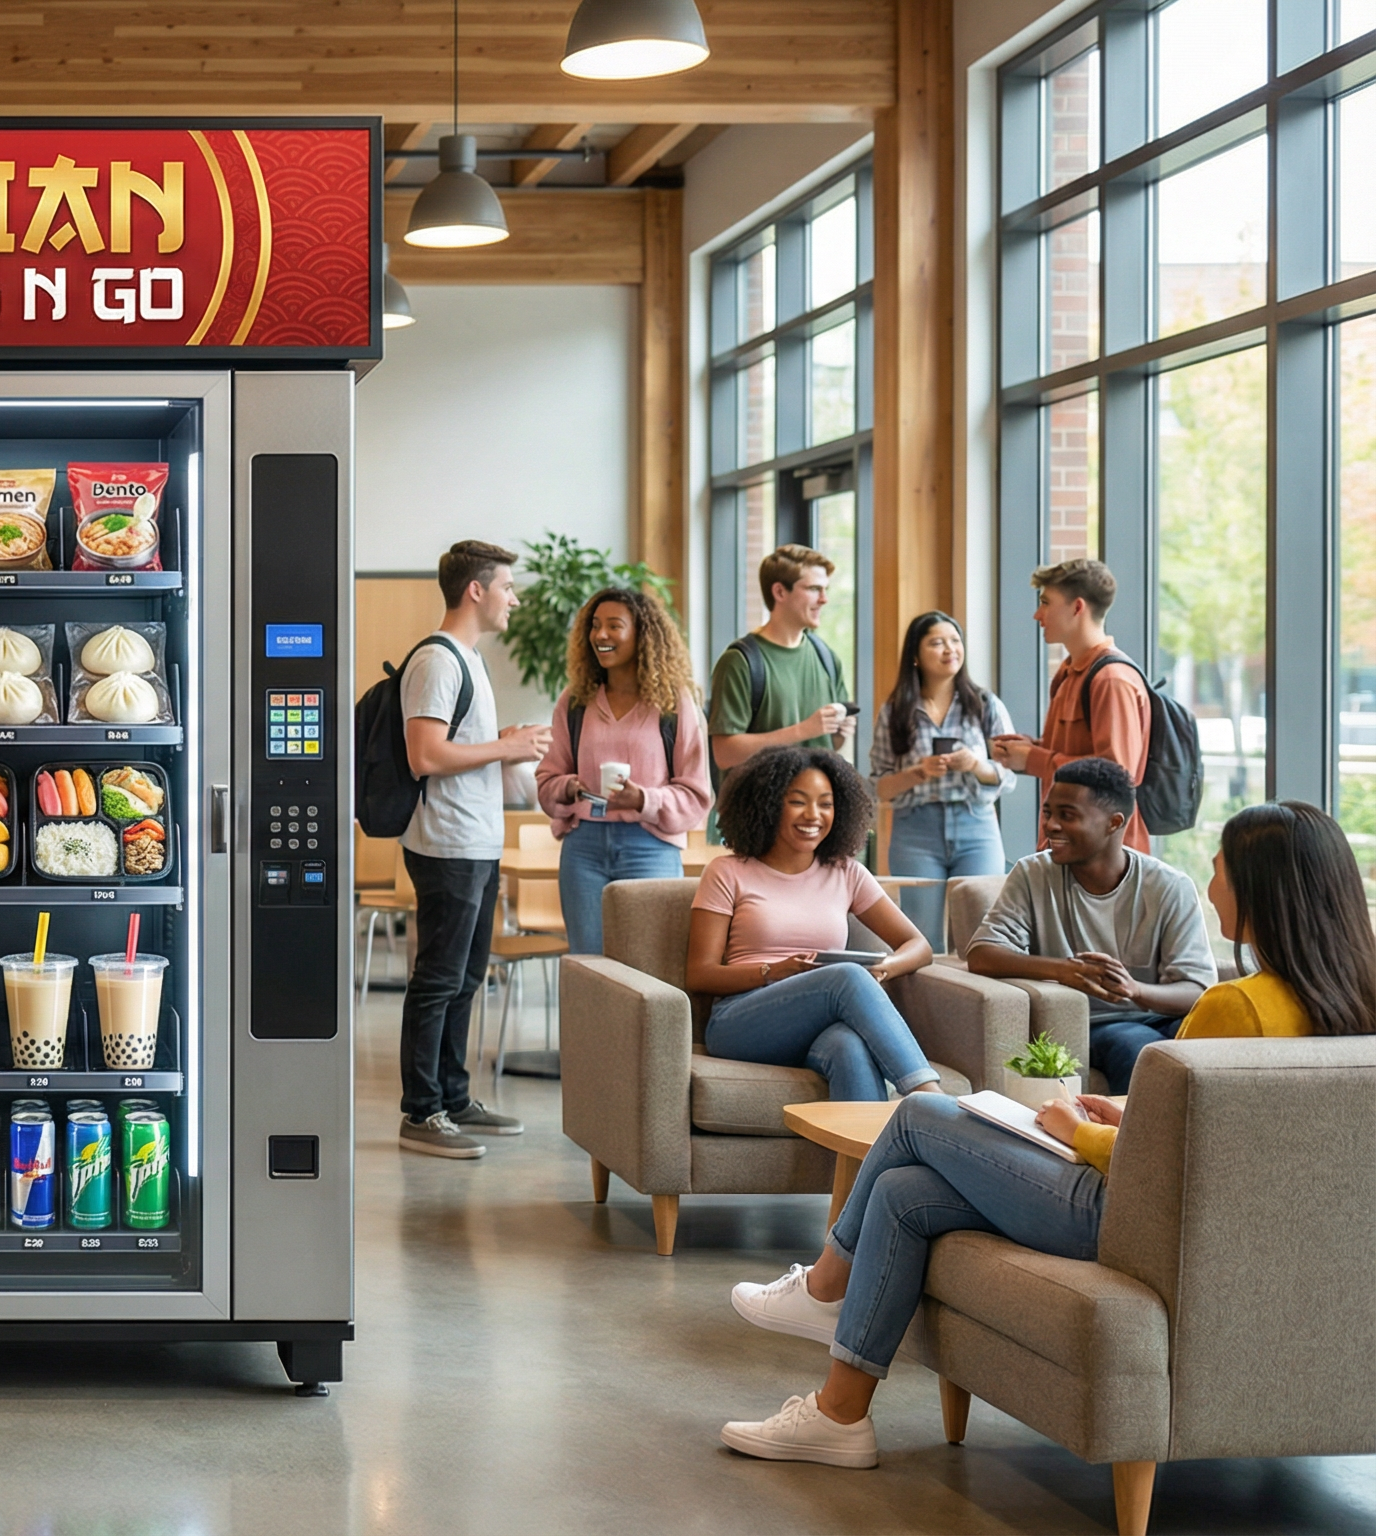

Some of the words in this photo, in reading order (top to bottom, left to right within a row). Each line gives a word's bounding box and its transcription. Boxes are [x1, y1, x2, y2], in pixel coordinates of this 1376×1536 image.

[23, 267, 67, 321] N
[91, 266, 184, 325] GO
[92, 482, 147, 497] Bento
